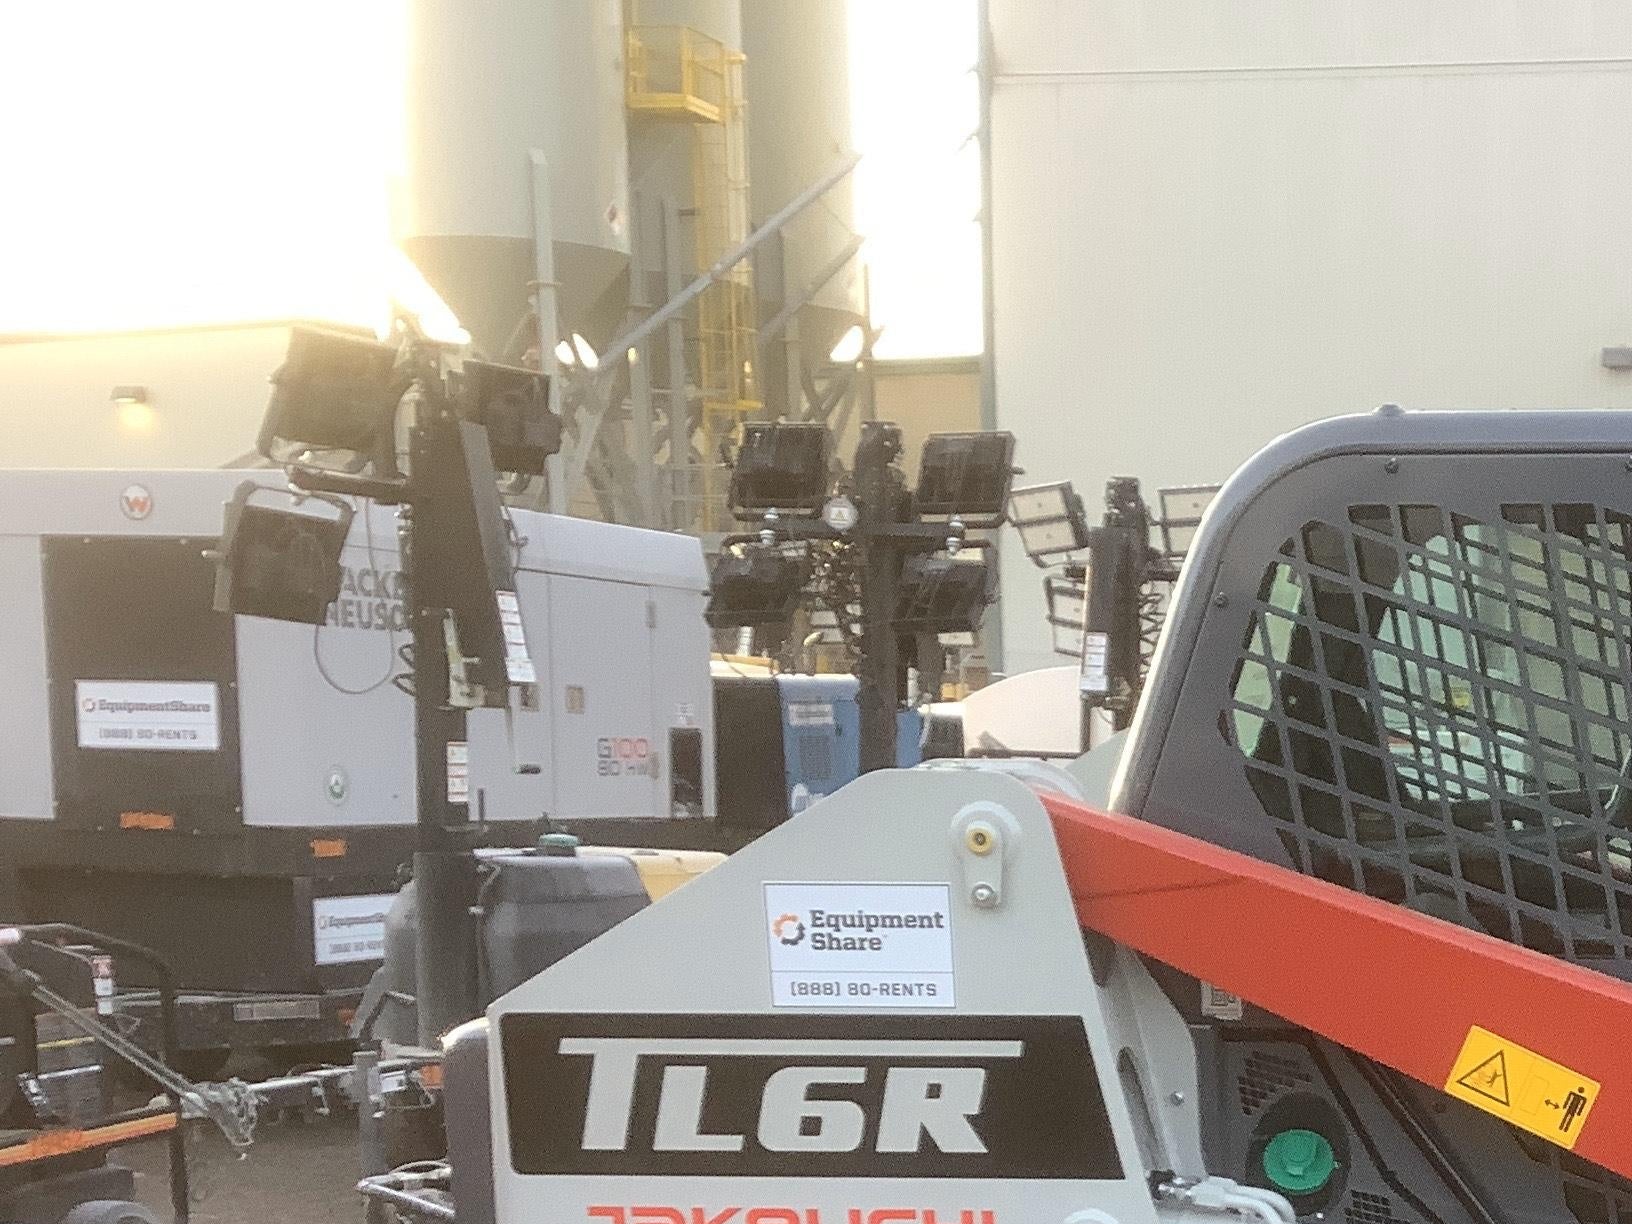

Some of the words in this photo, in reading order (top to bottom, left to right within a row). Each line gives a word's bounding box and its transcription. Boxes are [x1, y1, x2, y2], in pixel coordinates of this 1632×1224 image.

[809, 910, 944, 932] Equipment
[811, 933, 883, 951] Share
[848, 982, 937, 997] 80-RENTS
[557, 1037, 1024, 1154] TL6R
